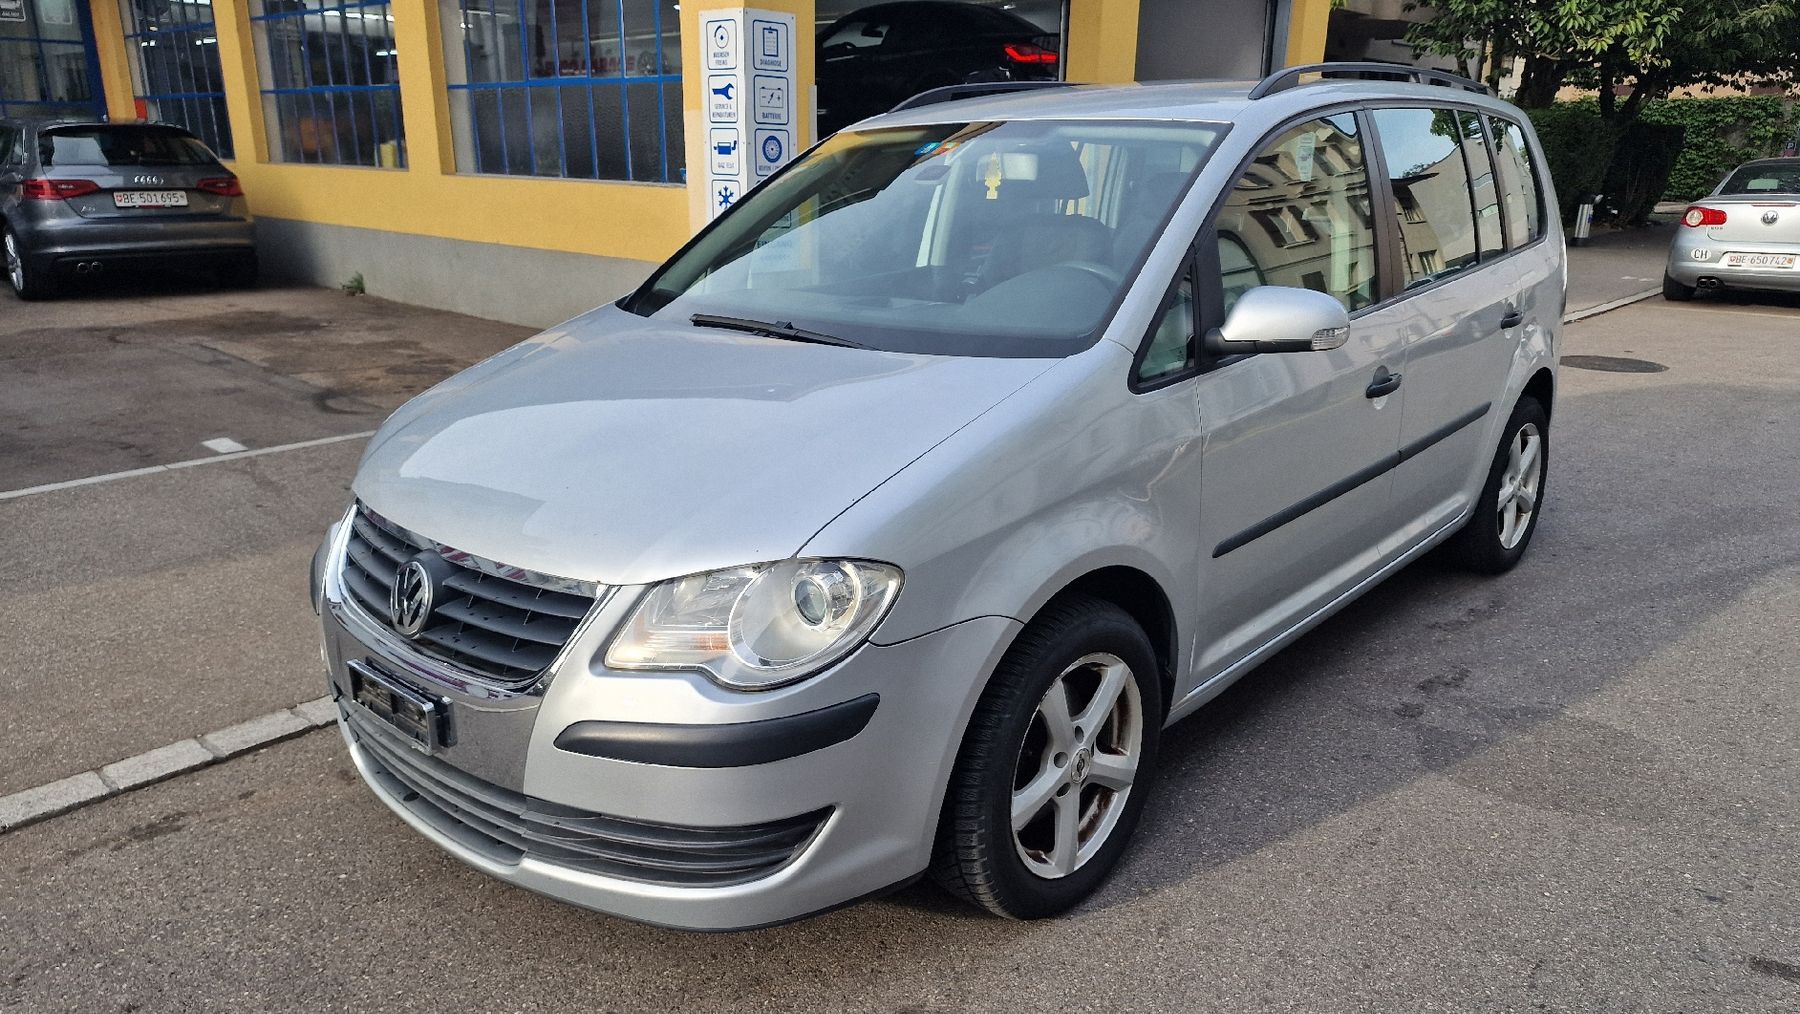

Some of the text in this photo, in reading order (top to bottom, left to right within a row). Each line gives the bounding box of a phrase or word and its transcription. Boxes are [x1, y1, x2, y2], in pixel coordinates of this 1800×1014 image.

[760, 58, 781, 67] DIAGNOSE
[762, 112, 781, 120] BATTERIE
[1694, 248, 1708, 259] CH
